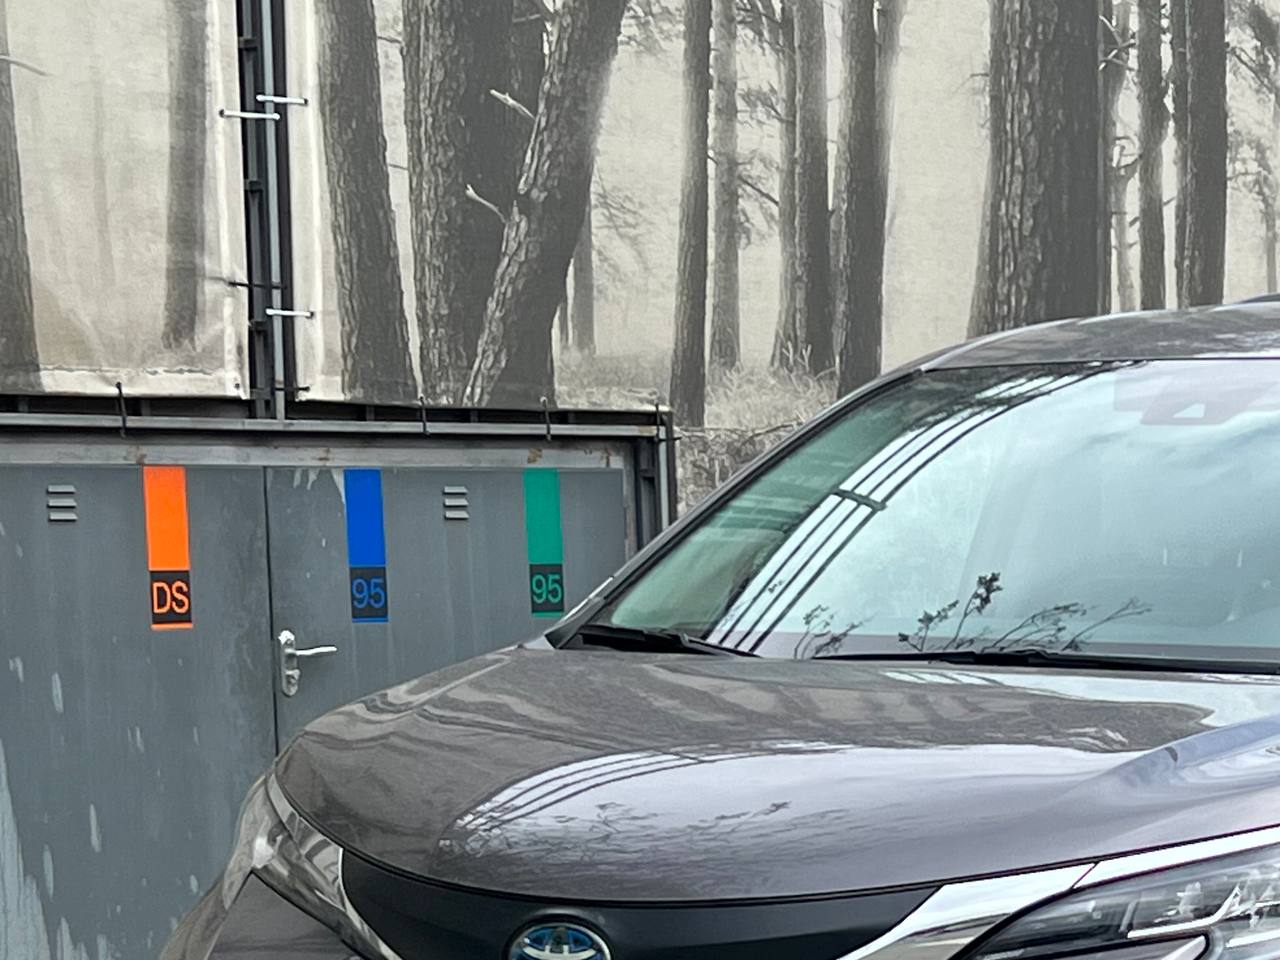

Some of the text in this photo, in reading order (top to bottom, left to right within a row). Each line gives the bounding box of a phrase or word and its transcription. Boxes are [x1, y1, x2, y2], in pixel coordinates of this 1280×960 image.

[152, 580, 189, 613] DS
[352, 578, 385, 608] 95
[532, 574, 562, 604] 95
